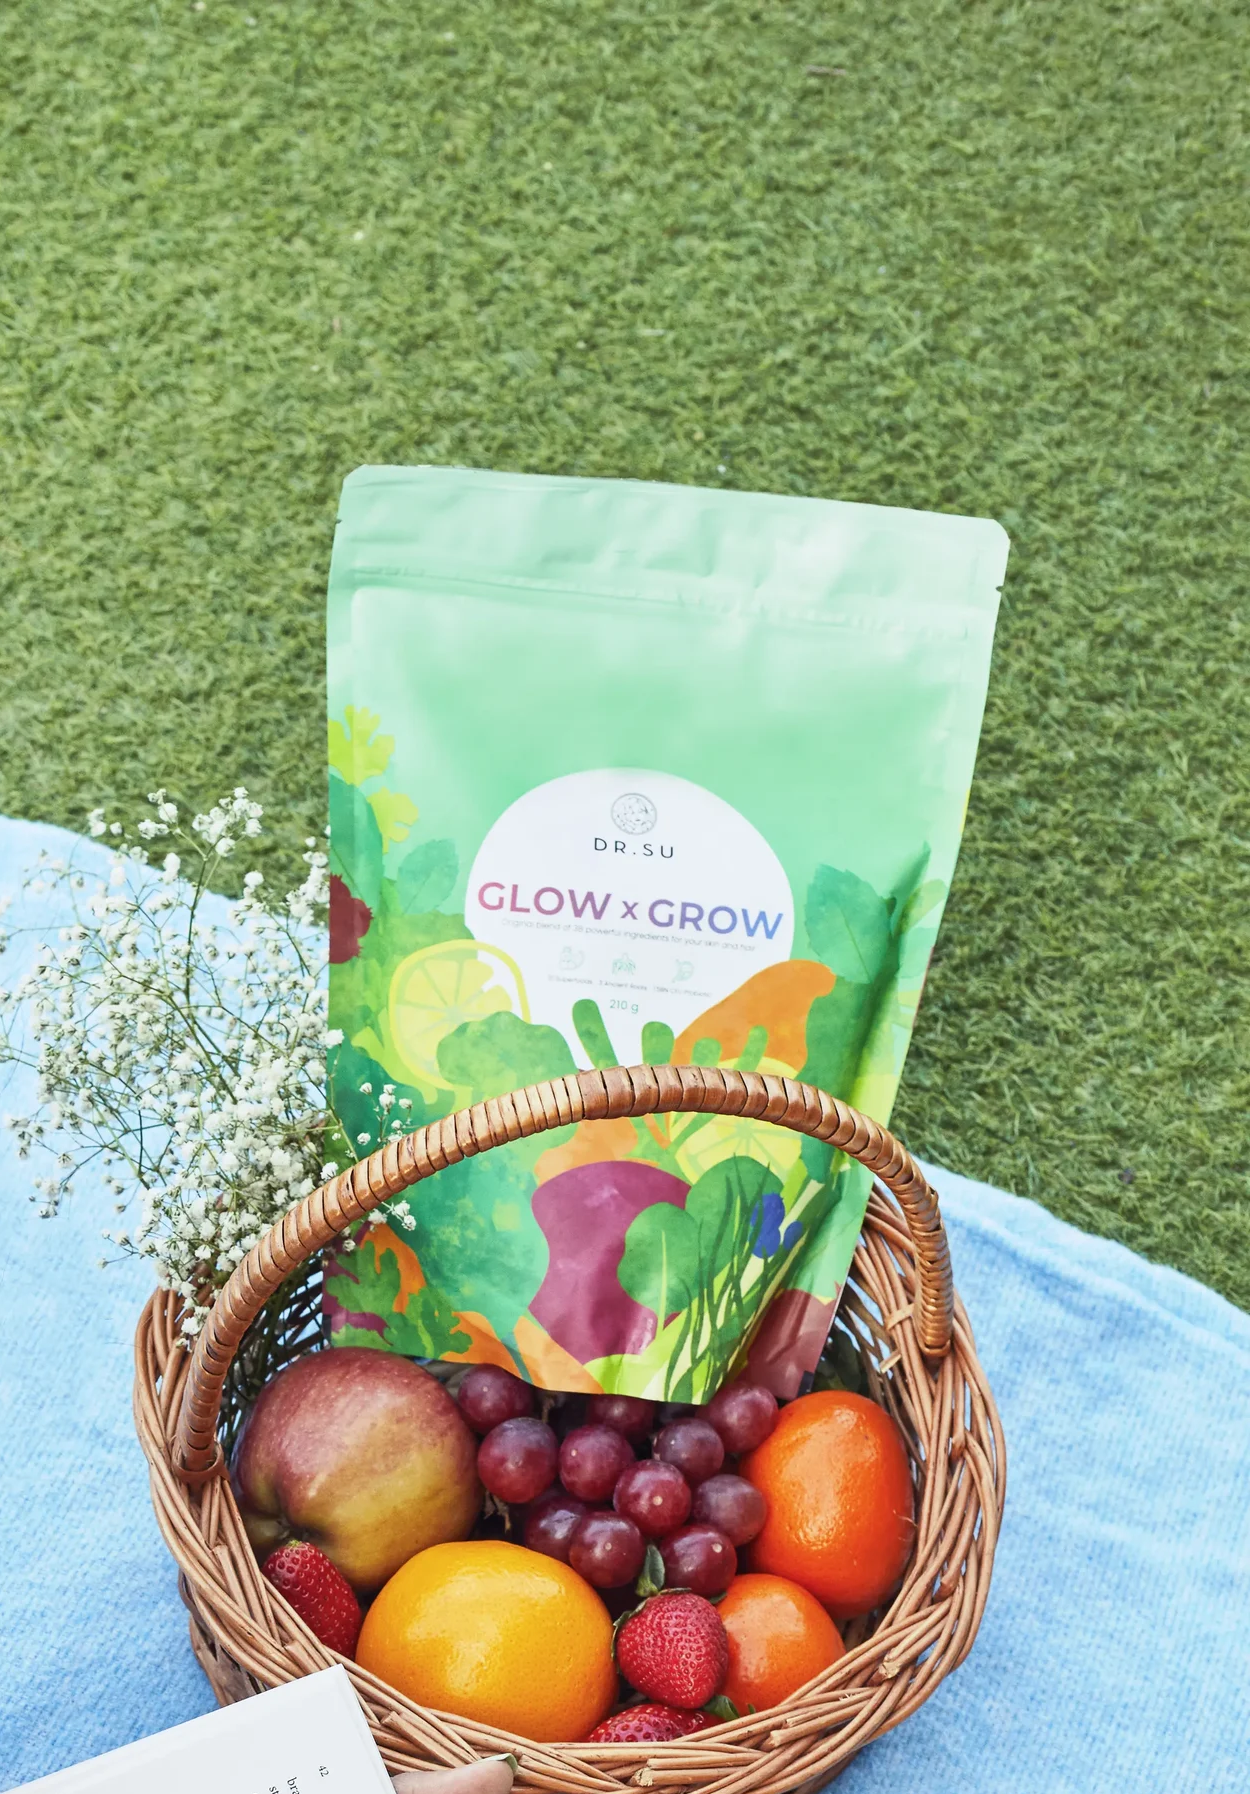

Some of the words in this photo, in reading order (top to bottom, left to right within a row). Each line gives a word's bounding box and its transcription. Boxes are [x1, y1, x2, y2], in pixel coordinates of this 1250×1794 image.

[593, 836, 676, 859] DR.SU
[477, 881, 612, 921] GLOW
[648, 898, 784, 941] GROW
[623, 930, 670, 943] ingredients
[609, 999, 628, 1011] 210
[631, 1002, 640, 1015] g
[317, 1764, 331, 1779] 42
